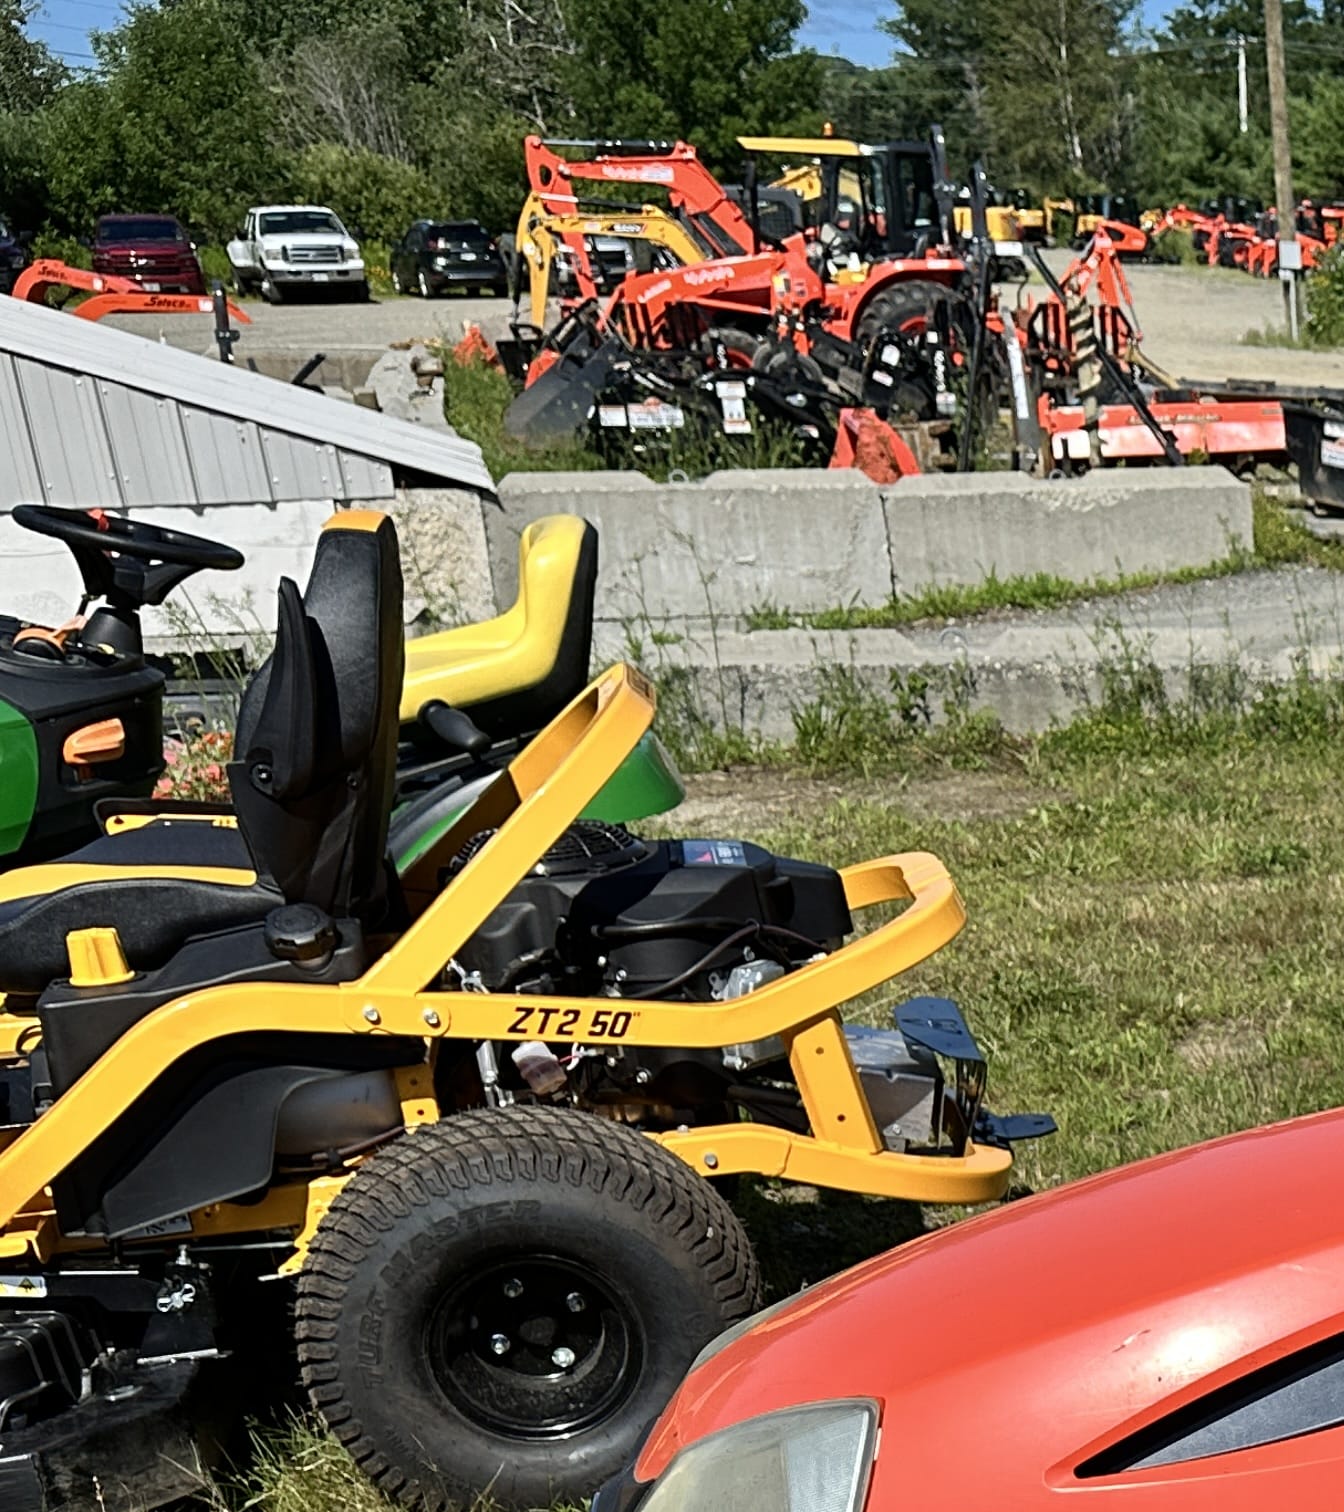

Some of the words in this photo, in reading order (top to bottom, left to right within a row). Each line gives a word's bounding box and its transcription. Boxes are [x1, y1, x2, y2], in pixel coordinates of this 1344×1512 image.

[508, 1006, 581, 1036] ZT2
[358, 1287, 388, 1390] TURF
[380, 1199, 541, 1289] MASTER
